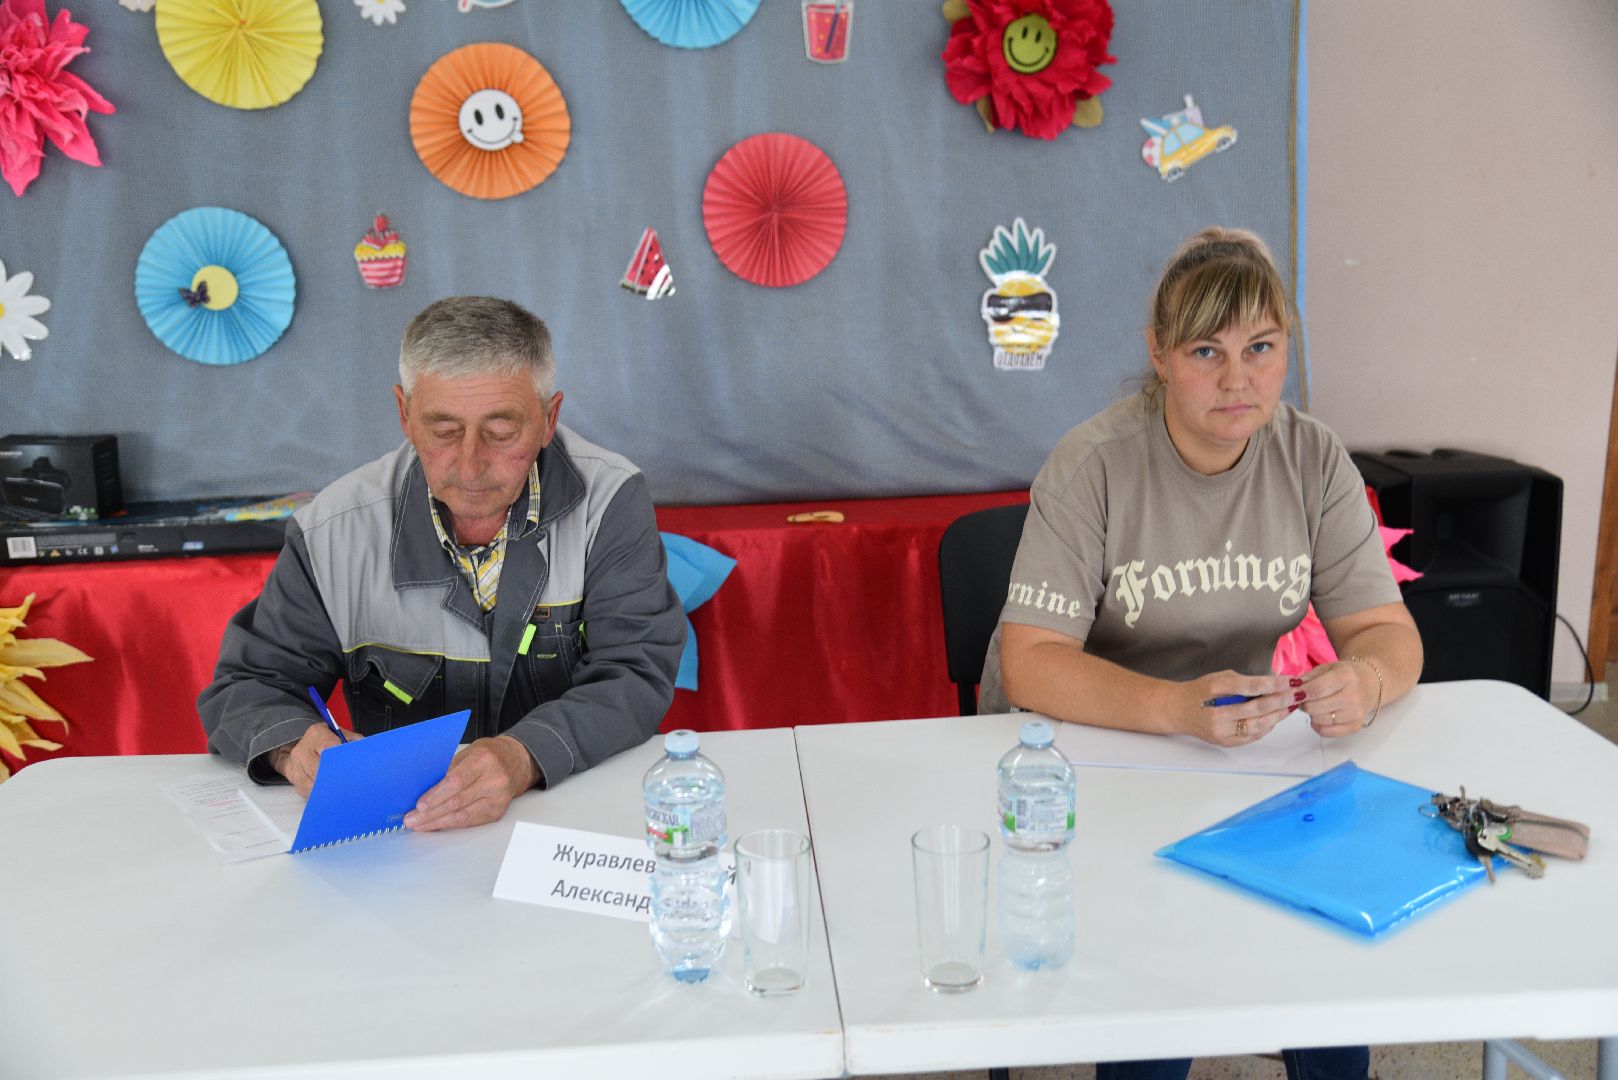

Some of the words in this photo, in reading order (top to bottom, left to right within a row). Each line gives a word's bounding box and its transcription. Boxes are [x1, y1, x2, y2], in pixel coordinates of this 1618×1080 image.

[1008, 580, 1081, 619] rnine
[553, 844, 656, 873] Журавлев
[551, 880, 650, 913] Александ
